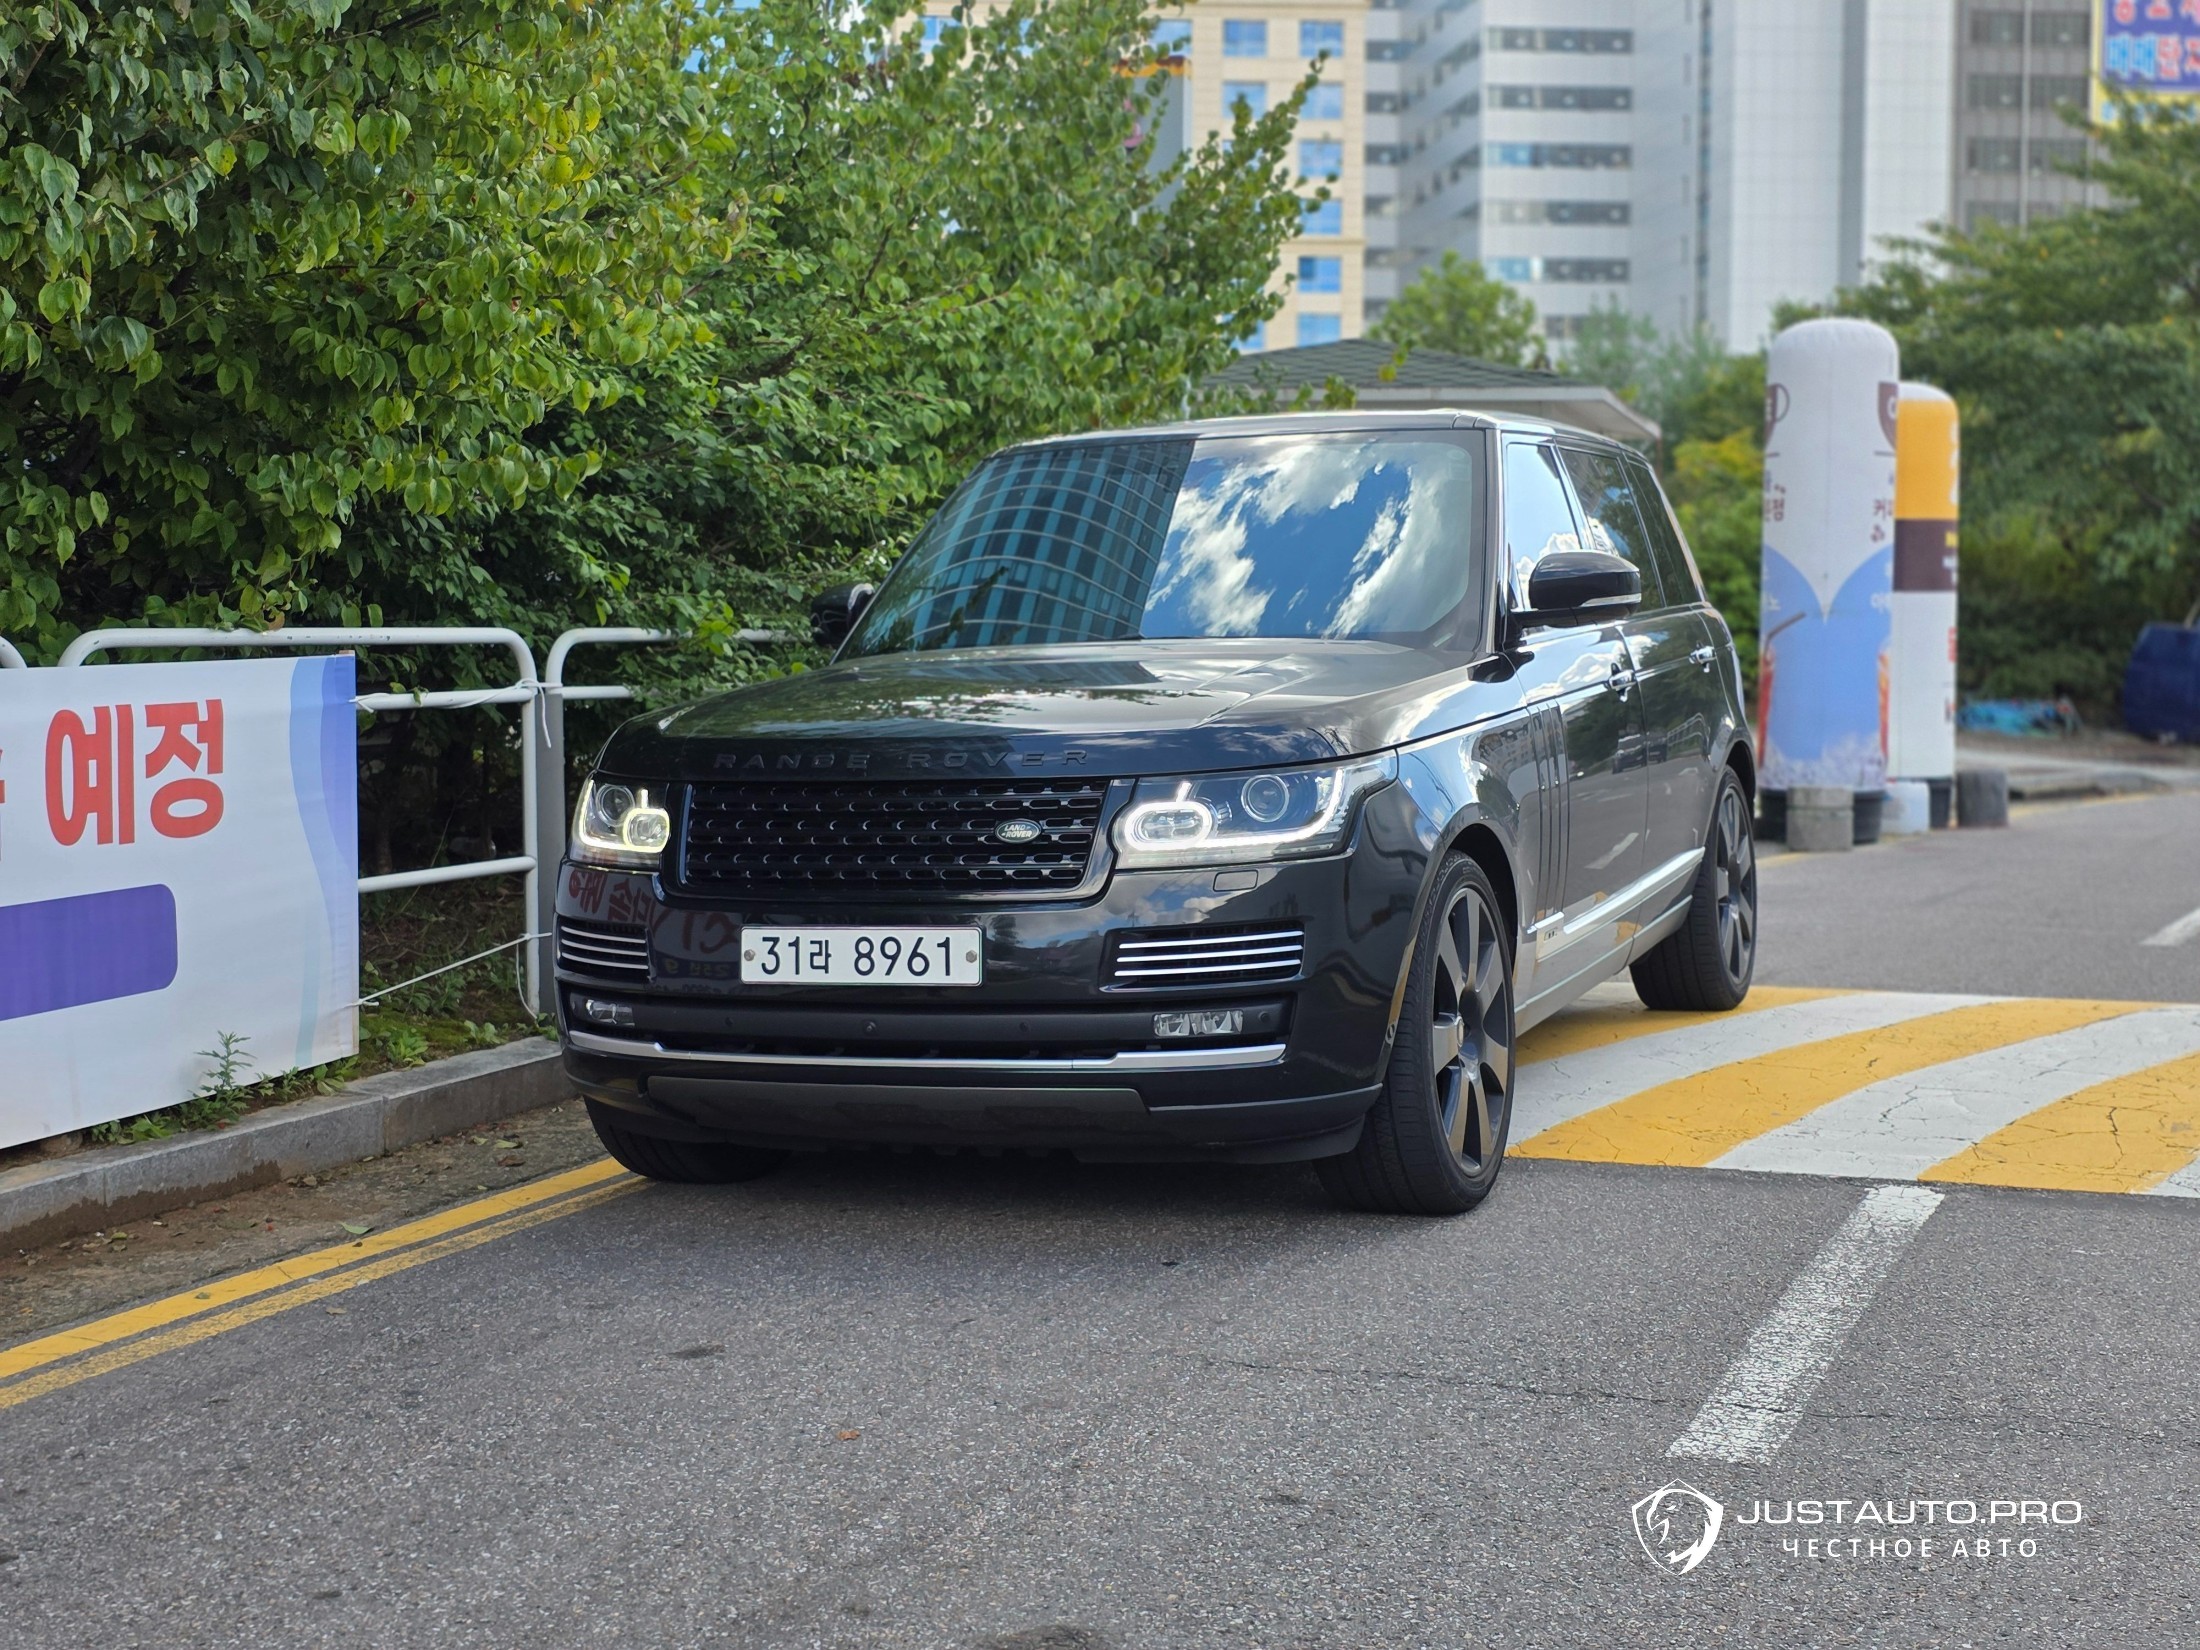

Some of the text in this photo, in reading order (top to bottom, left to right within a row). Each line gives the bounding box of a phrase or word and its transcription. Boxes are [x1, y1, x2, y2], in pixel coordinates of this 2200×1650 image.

[45, 698, 225, 847] 예정
[713, 750, 1089, 770] RANGE ROVER
[1005, 830, 1033, 838] ROVER
[760, 936, 832, 976] 31라
[854, 936, 952, 977] 8961
